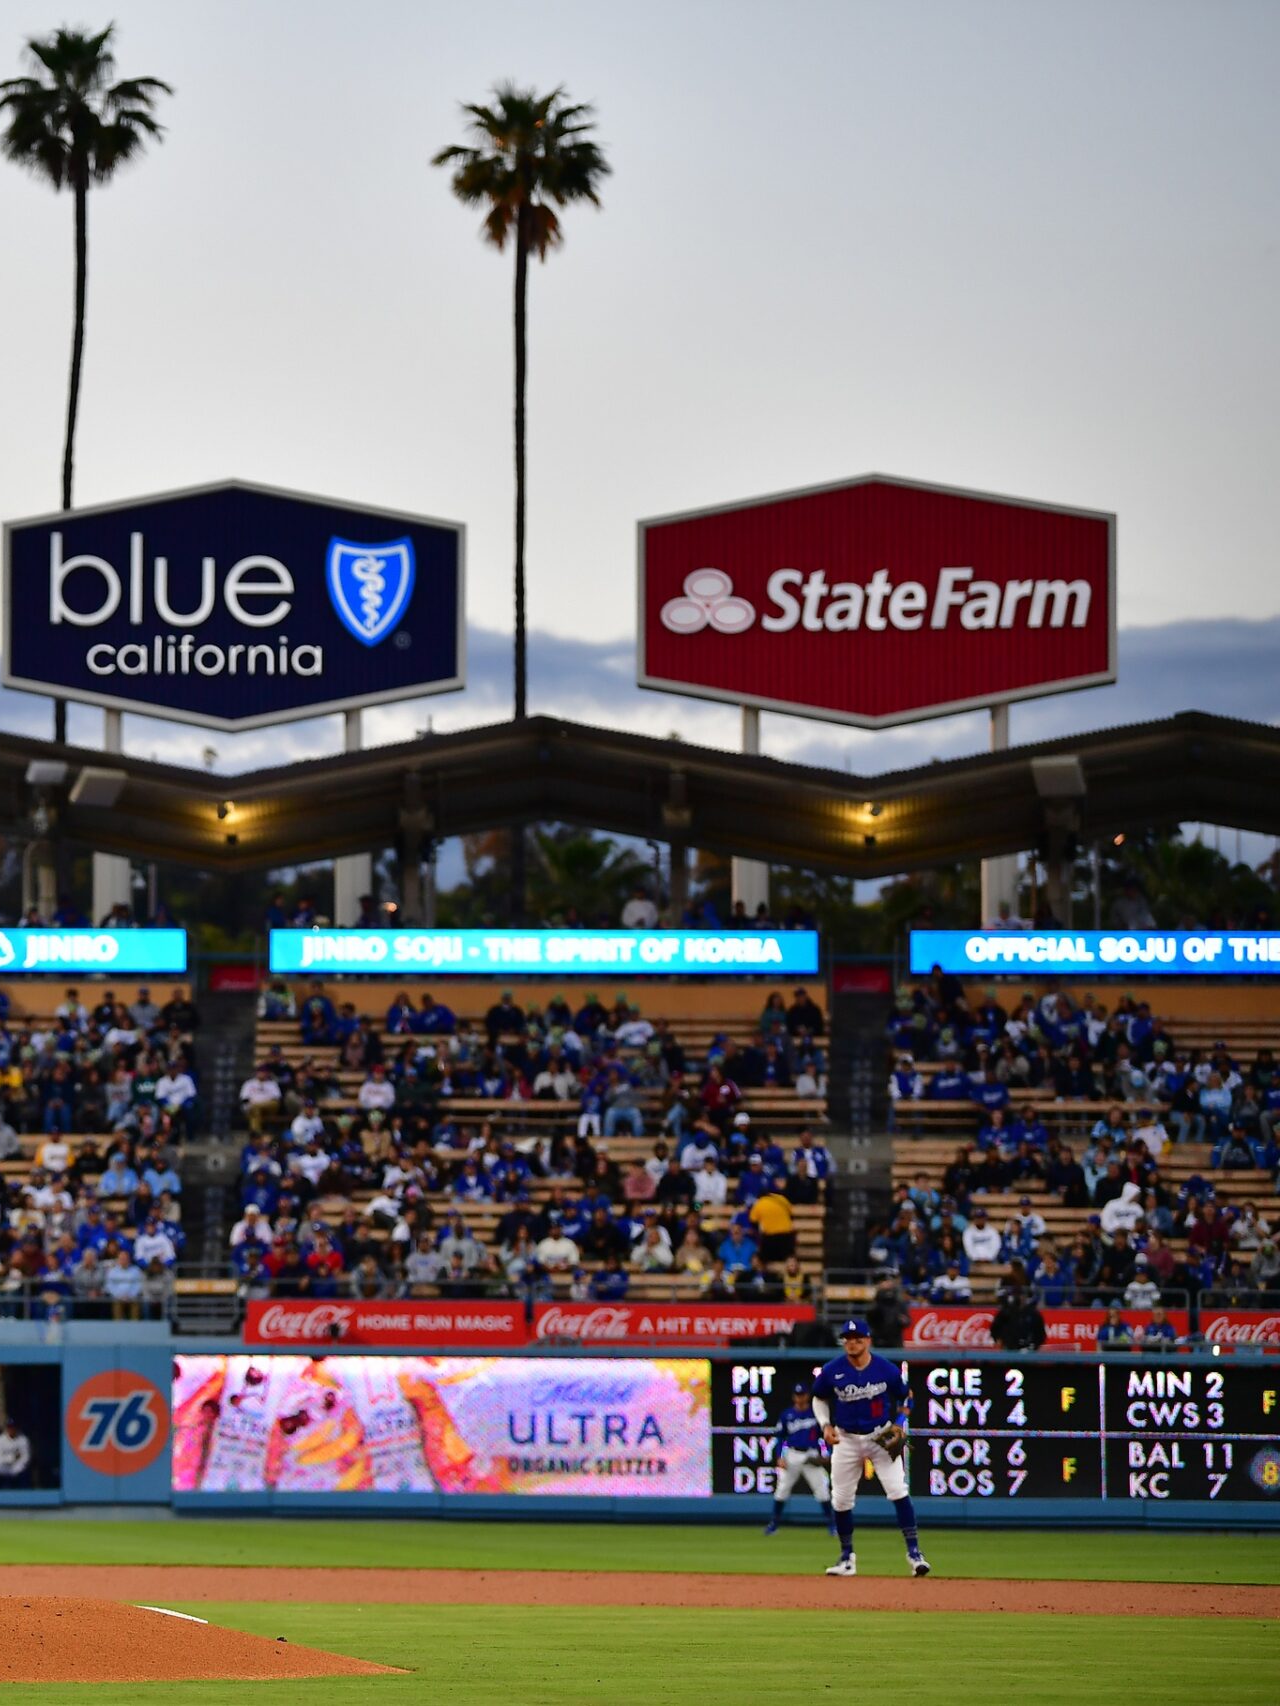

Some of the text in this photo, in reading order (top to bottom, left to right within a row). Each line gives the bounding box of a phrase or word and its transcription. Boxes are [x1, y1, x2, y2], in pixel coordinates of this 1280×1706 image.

[50, 531, 295, 627] blue
[86, 634, 323, 675] california
[24, 936, 119, 968] JINRO
[301, 936, 388, 967] JINRO
[394, 936, 463, 967] SOJU
[483, 937, 541, 963] THE
[546, 938, 636, 963] SPIRIT
[639, 938, 679, 963] OF
[683, 939, 783, 964] KOREA
[965, 937, 1280, 962] OFFICIAL SOJU OF THE
[357, 1313, 411, 1331] HOME
[414, 1314, 452, 1331] RUN
[455, 1315, 513, 1332] MAGIC
[638, 1316, 654, 1333] A
[656, 1317, 687, 1334] HIT
[693, 1317, 757, 1335] EVERY
[732, 1366, 776, 1395] PIT
[927, 1368, 1024, 1397] CLE 2
[1127, 1371, 1224, 1399] MIN 2
[732, 1396, 767, 1423] TB
[928, 1398, 1028, 1427] NYY 4
[1061, 1387, 1076, 1412] F
[1263, 1390, 1276, 1415] F
[82, 1391, 157, 1452] 76
[508, 1411, 665, 1446] ULTRA
[1126, 1401, 1225, 1429] CWS 3
[733, 1436, 777, 1464] NY
[928, 1438, 1027, 1466] TOR 6
[1128, 1441, 1233, 1469] BAL 11
[508, 1456, 668, 1476] ORGANIC SELTZER
[1062, 1457, 1077, 1483] F
[930, 1469, 1028, 1496] BOS 7
[1129, 1472, 1229, 1499] KC 7
